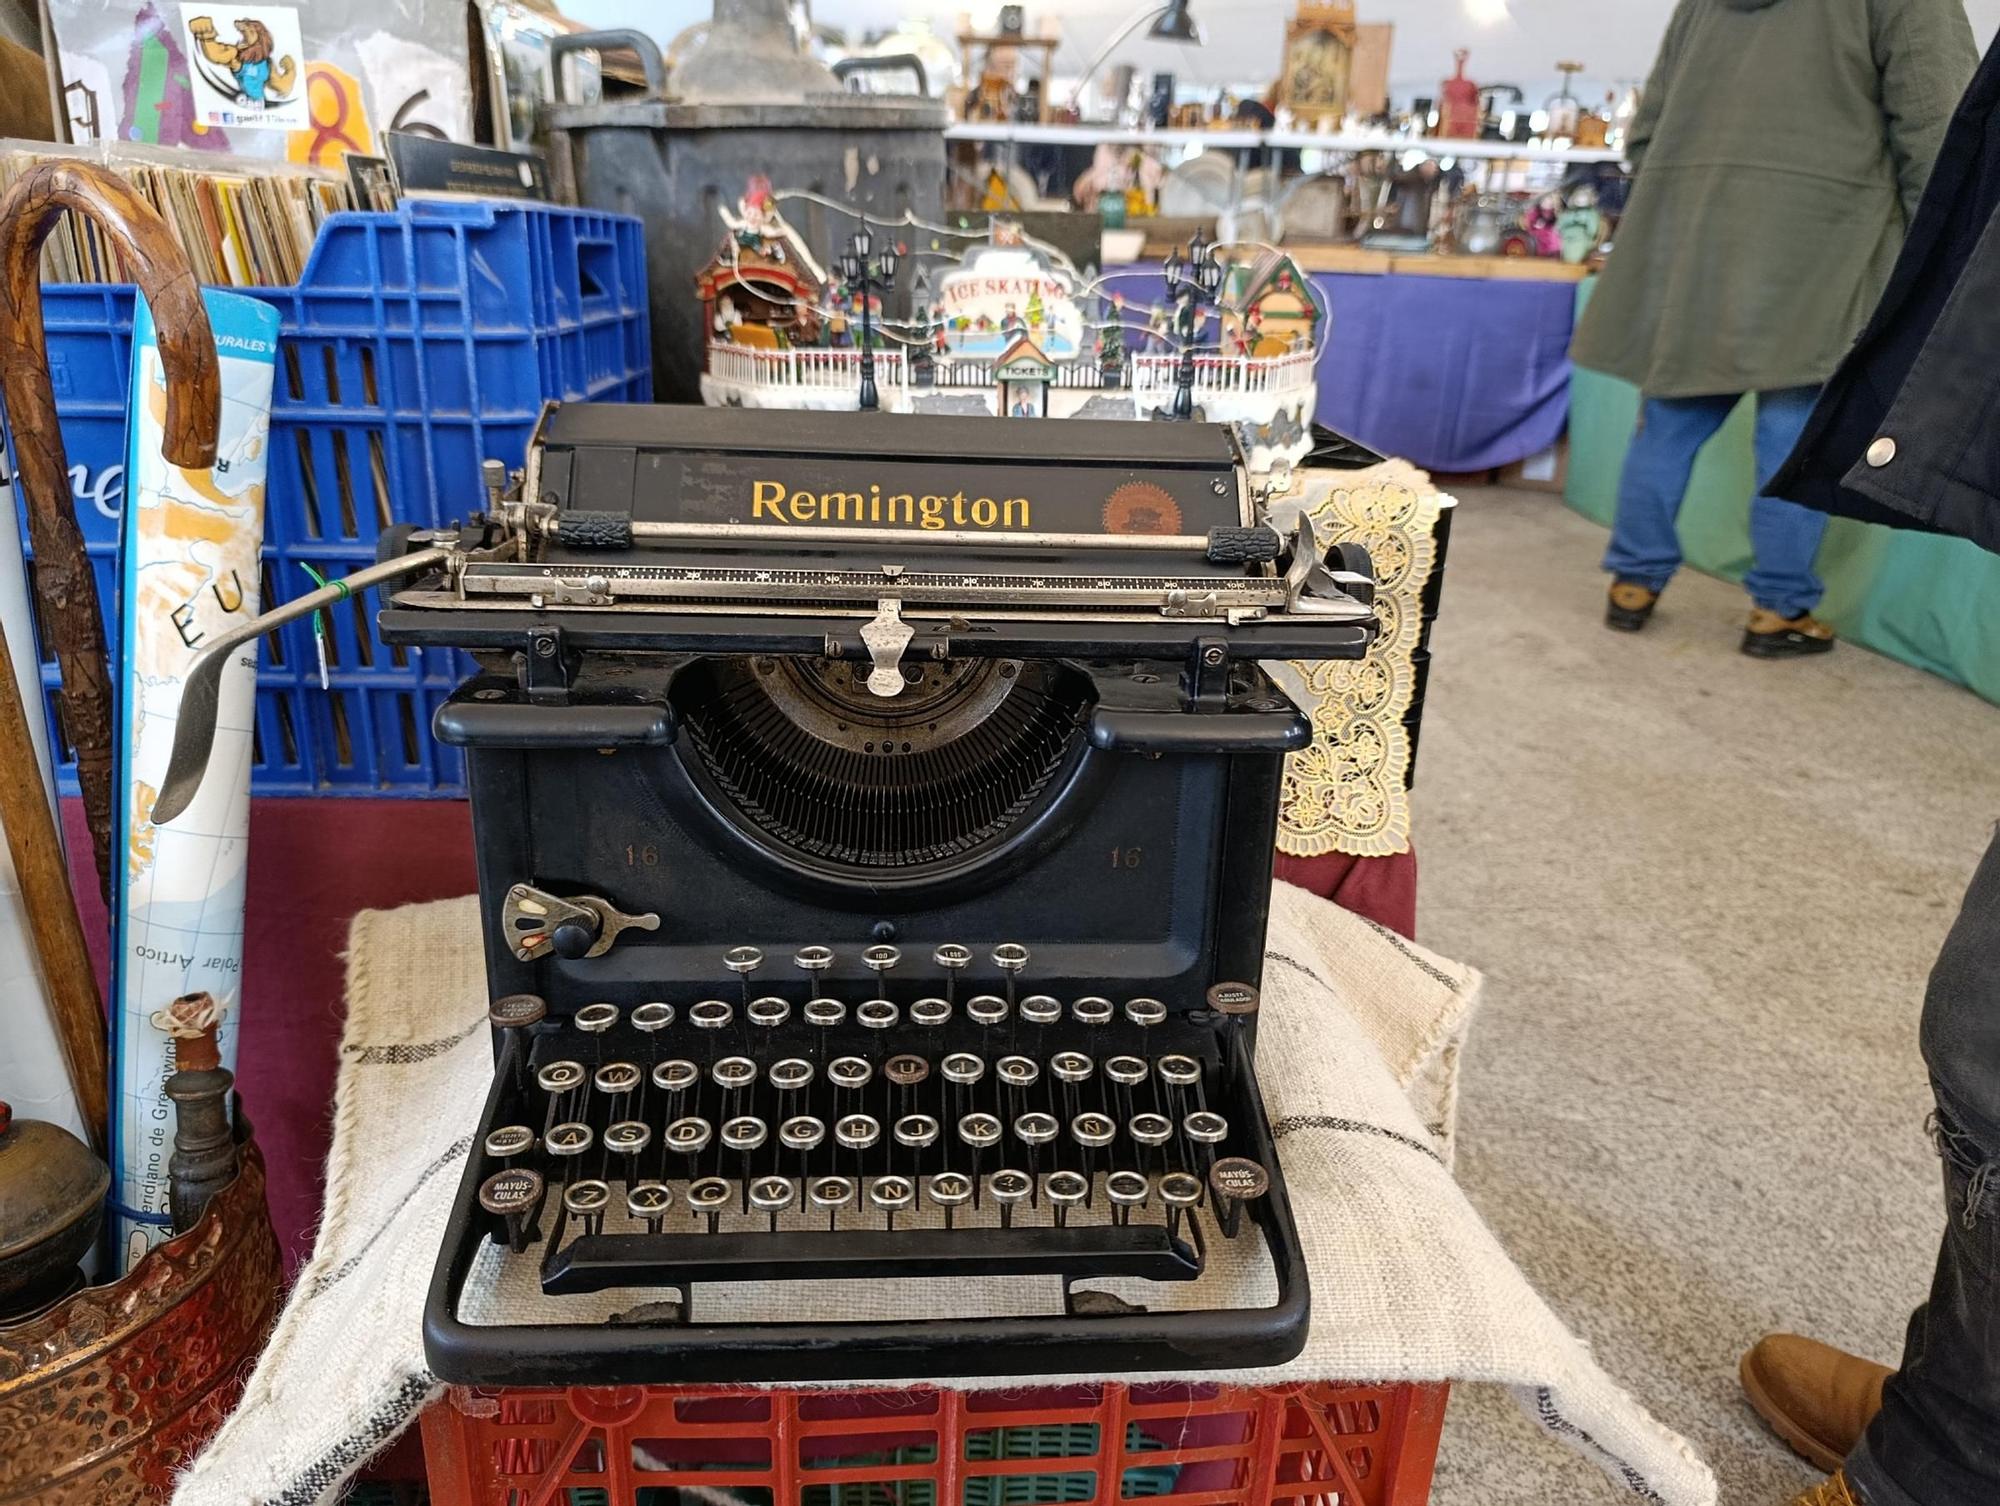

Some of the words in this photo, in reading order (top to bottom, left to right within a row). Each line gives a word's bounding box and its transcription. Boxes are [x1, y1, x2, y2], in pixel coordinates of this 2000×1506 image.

[948, 282, 980, 303] ICE
[214, 334, 267, 353] URALES
[1004, 366, 1050, 377] TICKETS
[752, 480, 1031, 531] Remington
[626, 844, 659, 867] 16
[1111, 846, 1142, 869] 16
[727, 1065, 743, 1078] R
[842, 1065, 858, 1077] Y
[900, 1062, 915, 1075] U
[1007, 1064, 1026, 1077] O
[1064, 1060, 1080, 1072] P
[551, 1068, 571, 1082] Q
[607, 1070, 631, 1083] W
[667, 1068, 684, 1080] E
[619, 1129, 637, 1142] S
[678, 1126, 697, 1140] D
[737, 1125, 753, 1139] F
[794, 1125, 811, 1138] G
[850, 1123, 867, 1137] H
[910, 1123, 923, 1136] J
[974, 1123, 989, 1136] K
[148, 1127, 166, 1147] de
[561, 1131, 579, 1145] A
[940, 1181, 960, 1195] M
[1225, 1178, 1256, 1188] CULAS
[493, 1190, 526, 1201] CULAS
[580, 1190, 600, 1204] Z
[701, 1186, 720, 1201] C
[765, 1184, 783, 1199] V
[825, 1185, 841, 1199] B
[884, 1184, 902, 1198] N
[644, 1191, 661, 1206] X
